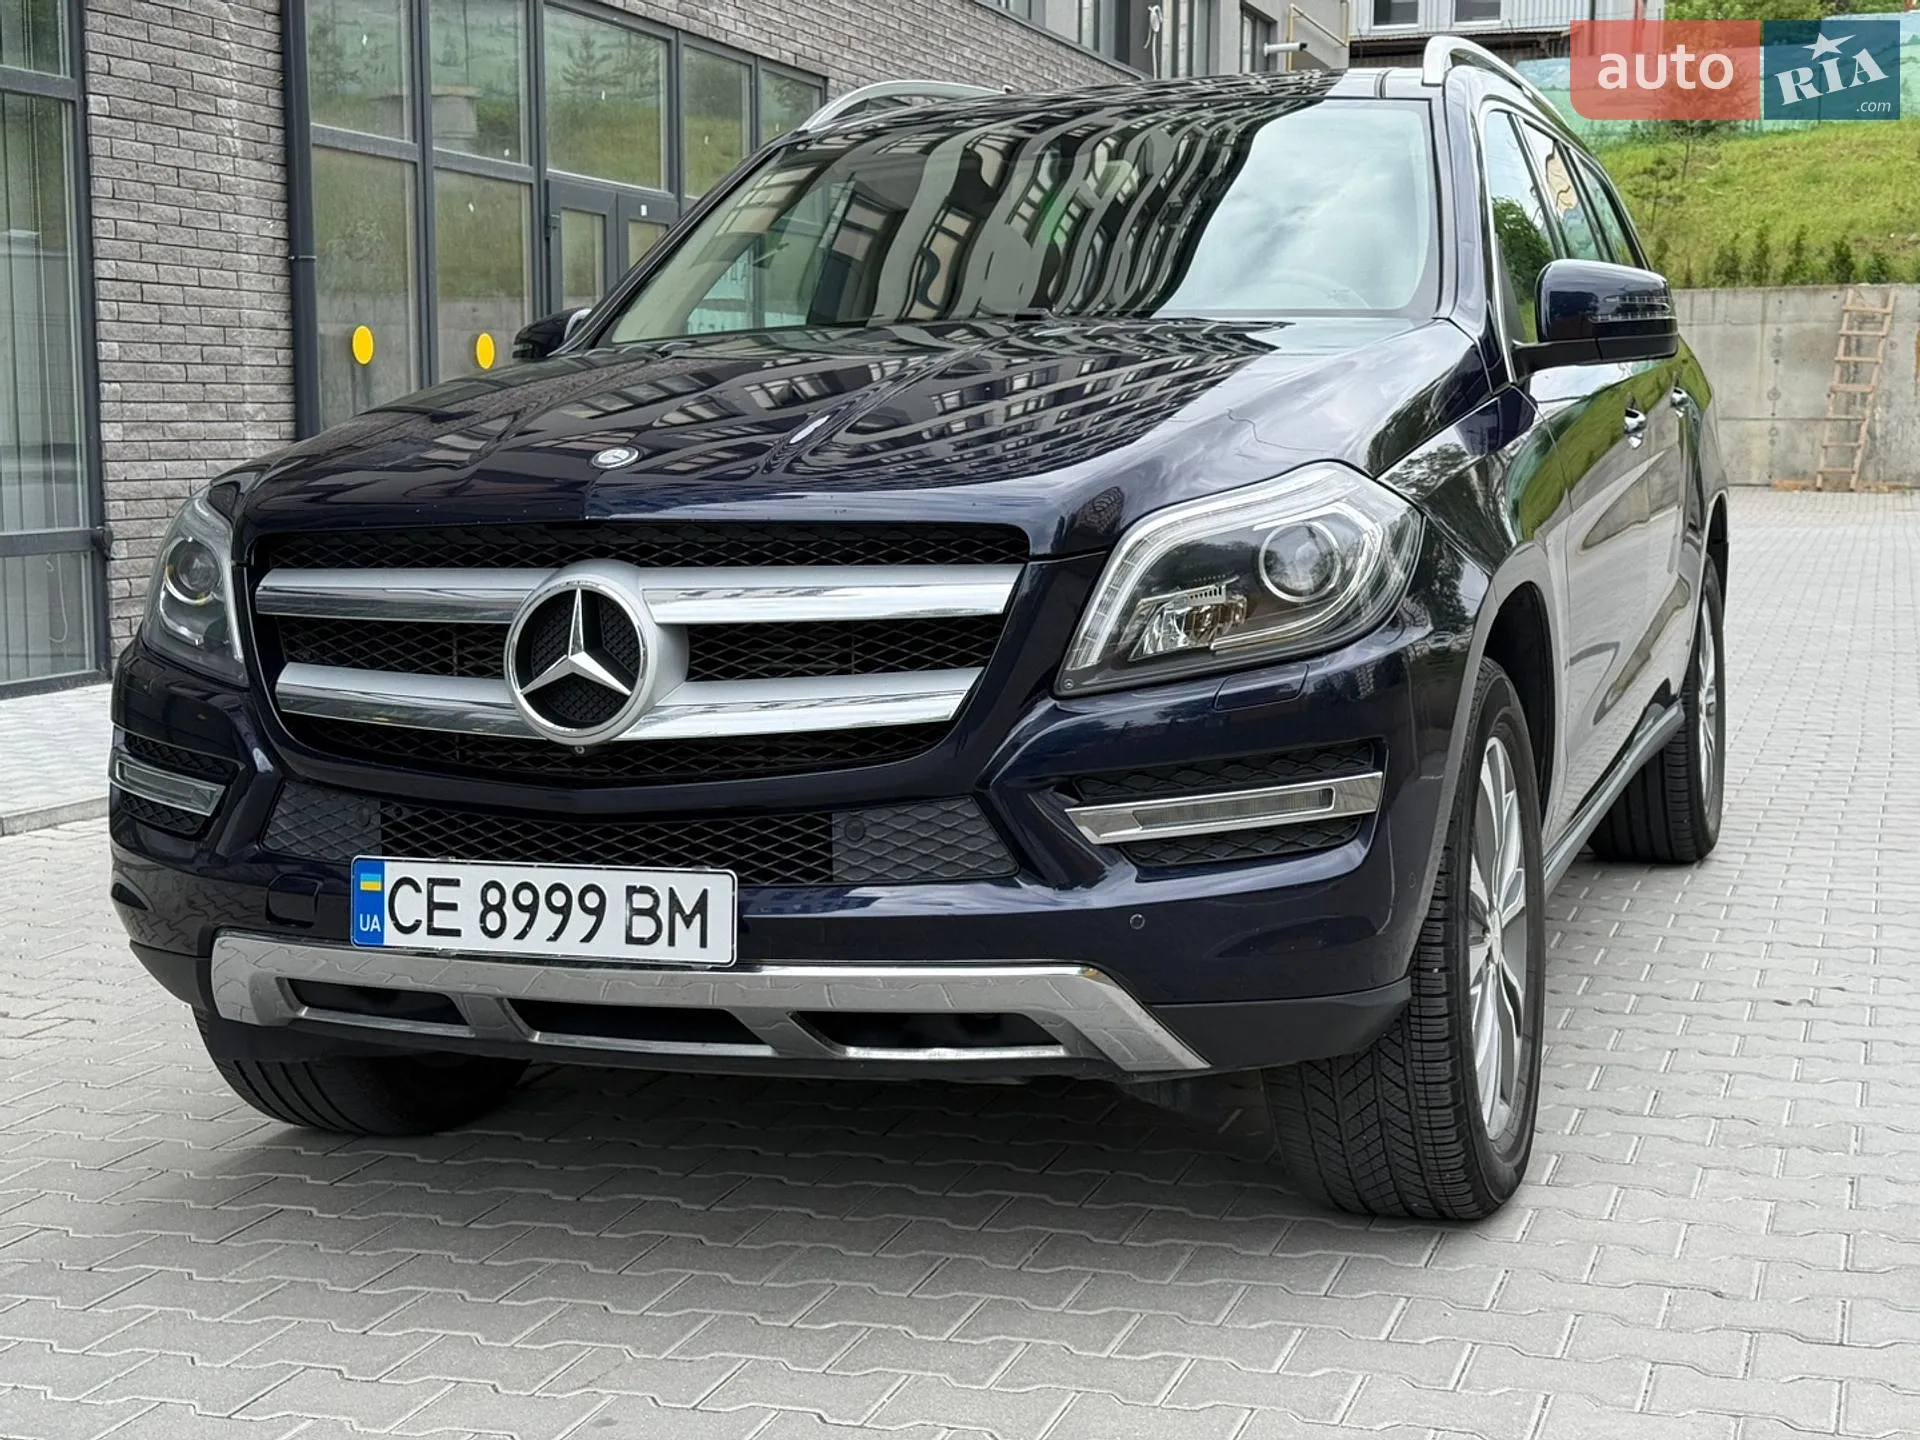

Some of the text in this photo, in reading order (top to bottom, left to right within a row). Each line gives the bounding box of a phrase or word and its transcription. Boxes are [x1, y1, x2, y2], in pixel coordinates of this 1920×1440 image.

[360, 913, 381, 932] UA
[388, 876, 709, 949] CE 8999 BM
